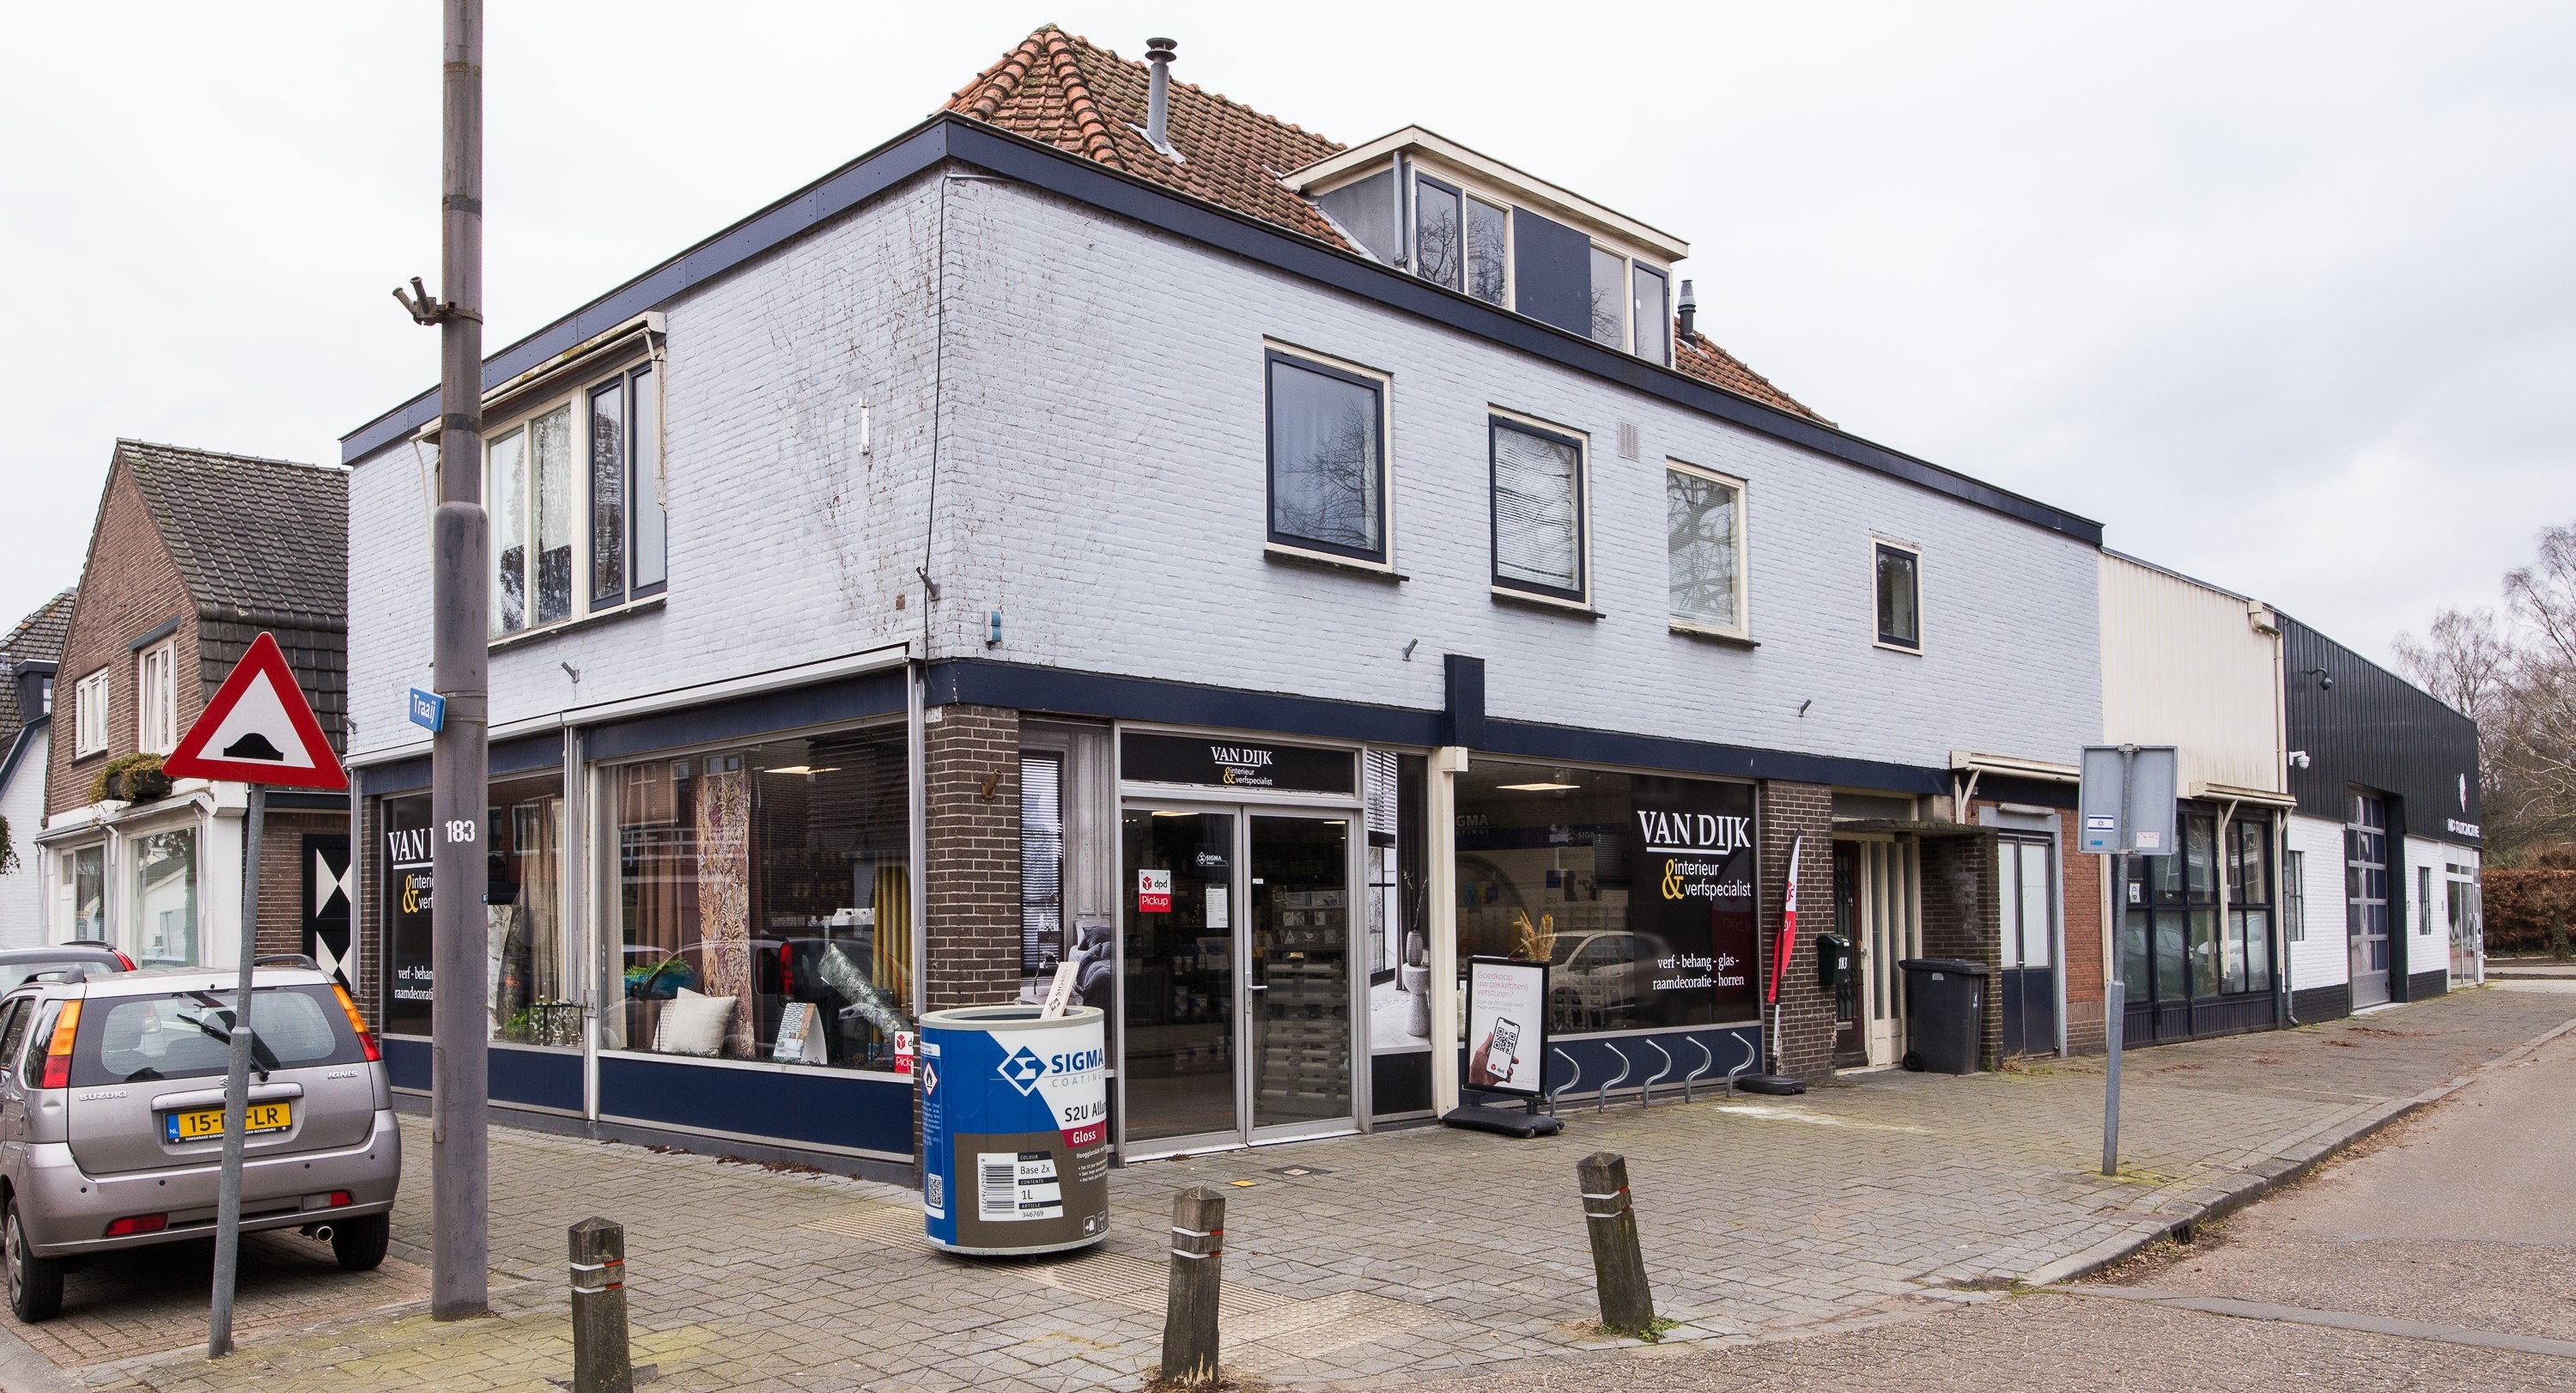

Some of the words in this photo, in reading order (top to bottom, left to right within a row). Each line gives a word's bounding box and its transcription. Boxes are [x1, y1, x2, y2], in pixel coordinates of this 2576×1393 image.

[413, 693, 436, 725] Traaij
[1210, 746, 1240, 763] VAN
[1242, 749, 1273, 767] DIJK
[1223, 766, 1236, 784] &
[1230, 767, 1255, 776] interieur
[1235, 776, 1273, 786] verfspecialist
[1456, 813, 1489, 827] GMA
[445, 819, 476, 843] 183
[1637, 810, 1692, 846] VAN
[1697, 814, 1751, 855] DIJK
[388, 828, 425, 862] VAN
[411, 872, 433, 890] interi
[1154, 879, 1168, 891] dpd
[1662, 859, 1685, 900] &
[1674, 858, 1719, 876] interieur
[1685, 878, 1752, 901] verfspecialist
[1141, 896, 1169, 908] Pickup
[1657, 953, 1675, 969] verf
[1681, 952, 1712, 971] behang
[1718, 952, 1735, 970] glas
[1838, 956, 1848, 970] 183
[398, 966, 410, 980] verf
[415, 965, 433, 980] behan
[1477, 971, 1513, 982] Goedkoop
[1055, 969, 1070, 997] SIGMA
[1489, 982, 1528, 992] pakket(ten)
[1652, 974, 1712, 990] raamdecoratie
[1718, 971, 1745, 987] horren
[394, 986, 433, 1001] raamdecorati
[1477, 989, 1514, 998] versturen?
[896, 1055, 912, 1067] Pick
[1051, 1047, 1104, 1074] SIGMA
[327, 1069, 359, 1080] IGNIS
[78, 1090, 128, 1101] SUZUKI
[189, 1107, 280, 1133] 15--LR
[1065, 1104, 1089, 1122] S2U
[1072, 1129, 1097, 1144] Gloss
[1020, 1165, 1039, 1175] Base
[1041, 1165, 1050, 1173] Zx
[1021, 1189, 1034, 1201] 1L
